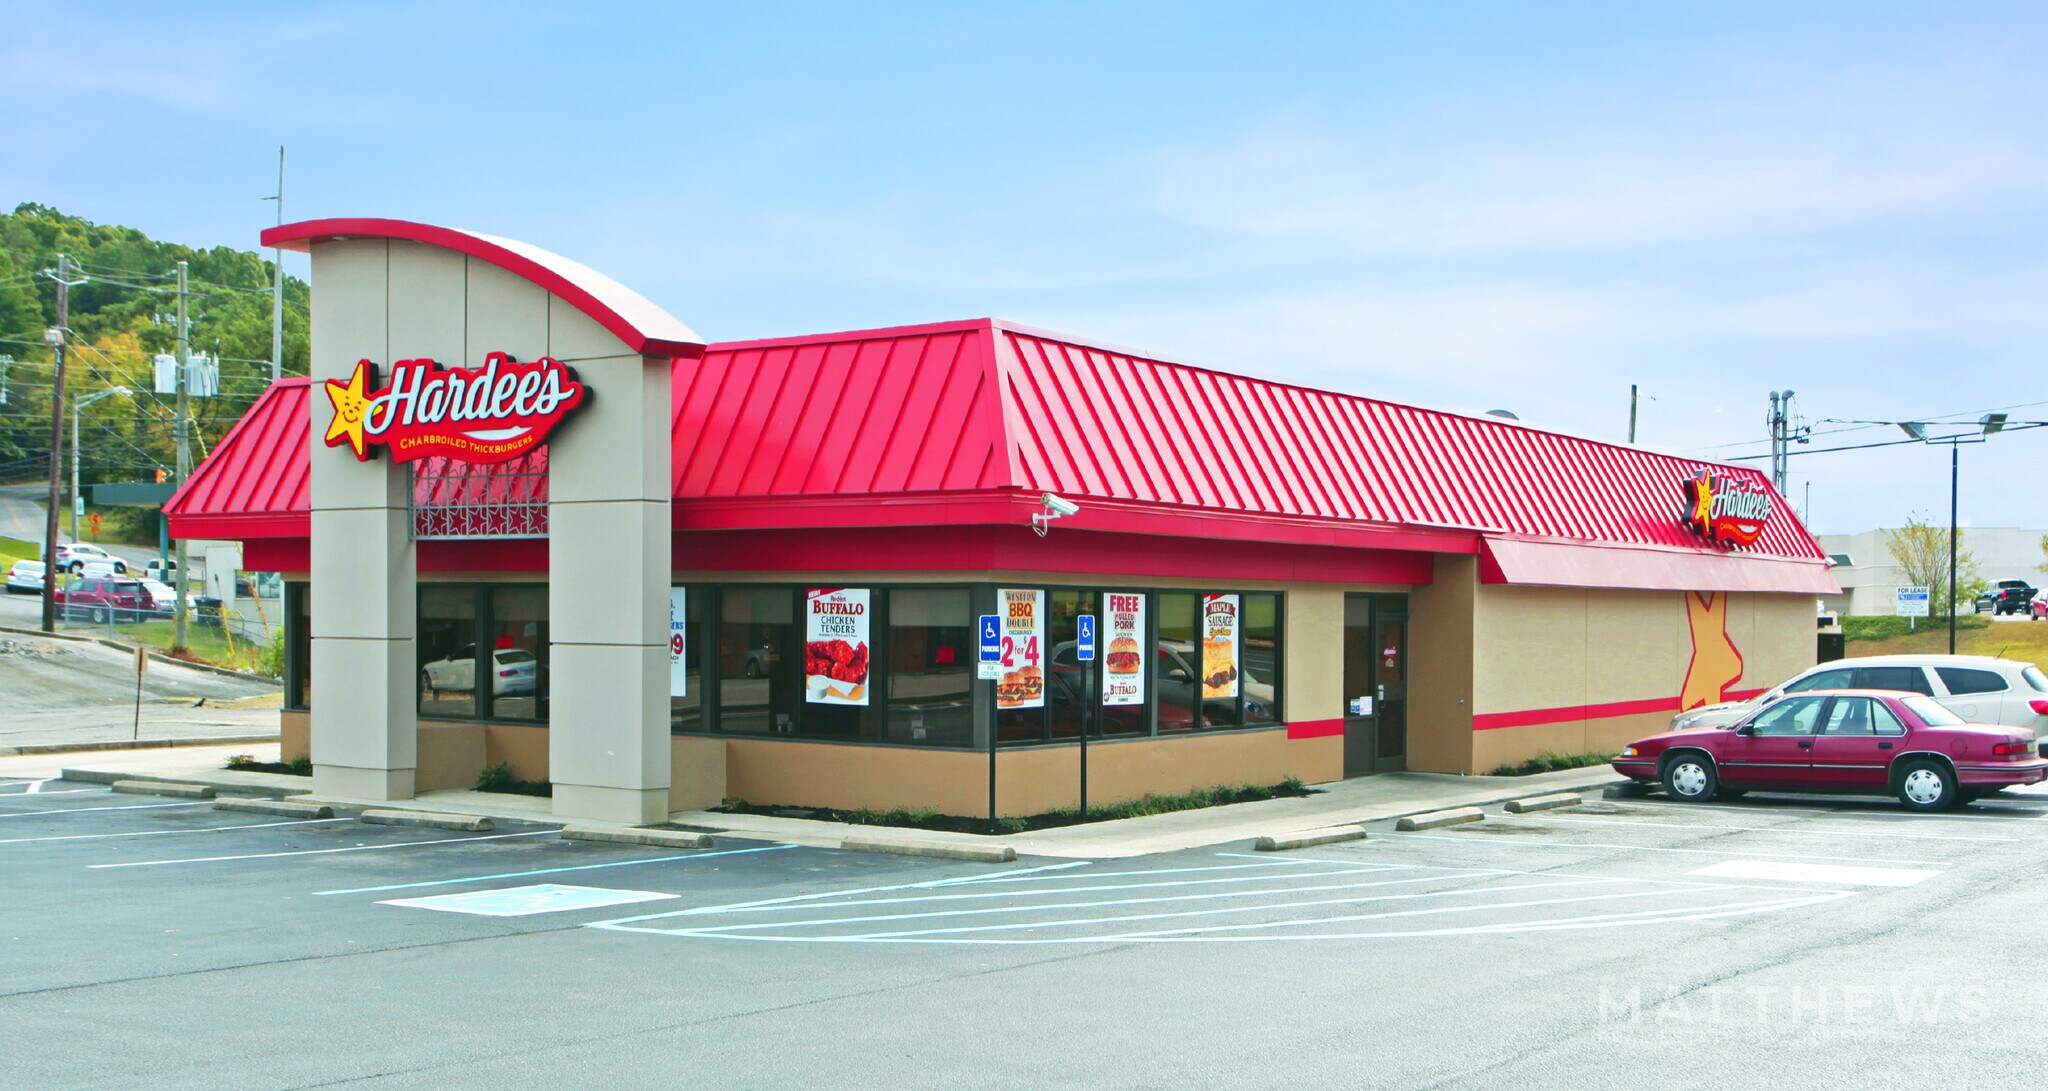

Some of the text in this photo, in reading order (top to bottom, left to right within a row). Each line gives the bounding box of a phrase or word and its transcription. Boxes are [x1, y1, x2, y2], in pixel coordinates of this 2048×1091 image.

[363, 358, 575, 435] Hardee's
[400, 434, 533, 454] CHARBROILED THICKBURGERS
[1709, 477, 1772, 521] Hardee's
[1006, 592, 1036, 602] WESTERN
[813, 600, 864, 615] BUFFALO
[1109, 595, 1139, 612] FREE
[1210, 603, 1231, 613] MAPLE
[1009, 603, 1033, 617] BBQ
[821, 616, 855, 625] CHICKEN
[1006, 617, 1034, 628] DOUBLE
[1114, 613, 1135, 621] PULLED
[1208, 616, 1234, 627] SAUSAGE
[821, 625, 856, 633] TENDERS
[1114, 621, 1135, 630] PORK
[1001, 635, 1014, 666] 2
[1015, 645, 1024, 655] for
[1110, 684, 1137, 695] BUFFALO
